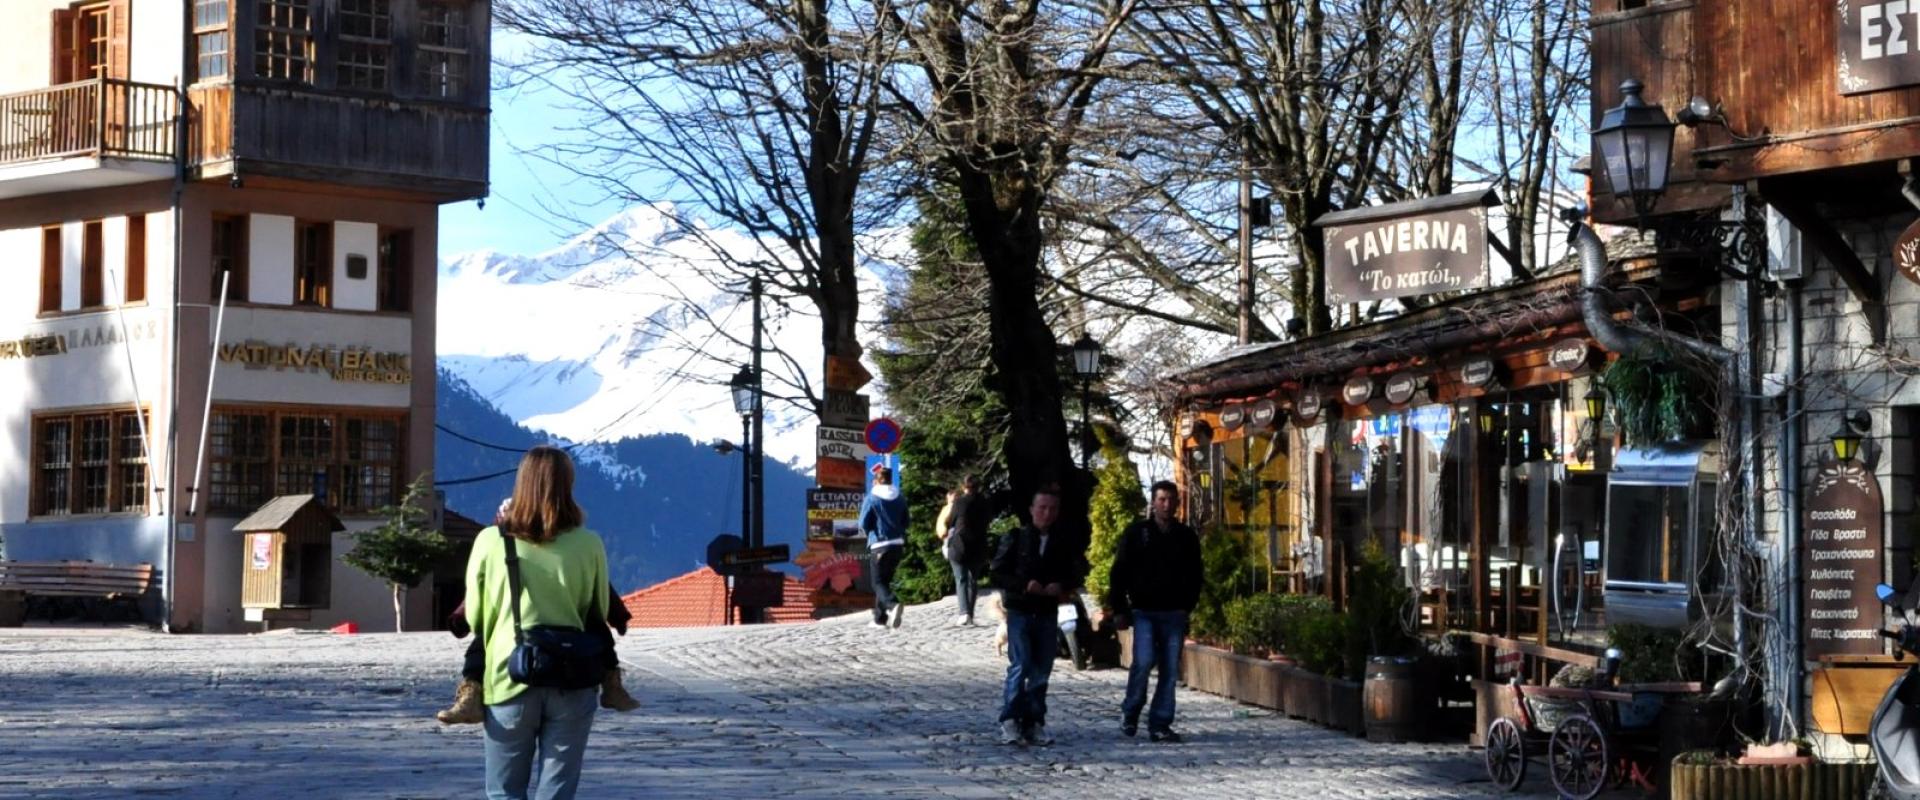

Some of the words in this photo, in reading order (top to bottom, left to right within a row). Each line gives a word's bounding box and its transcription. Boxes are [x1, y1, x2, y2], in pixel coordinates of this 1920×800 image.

[1344, 220, 1468, 266] TAVERNA
[215, 342, 338, 370] NATIONAL
[341, 347, 412, 371] BANK
[366, 370, 413, 385] GROUP
[821, 443, 856, 460] HOTEL
[1810, 508, 1857, 520] Φασολάδα
[1833, 527, 1867, 541] Βραστή
